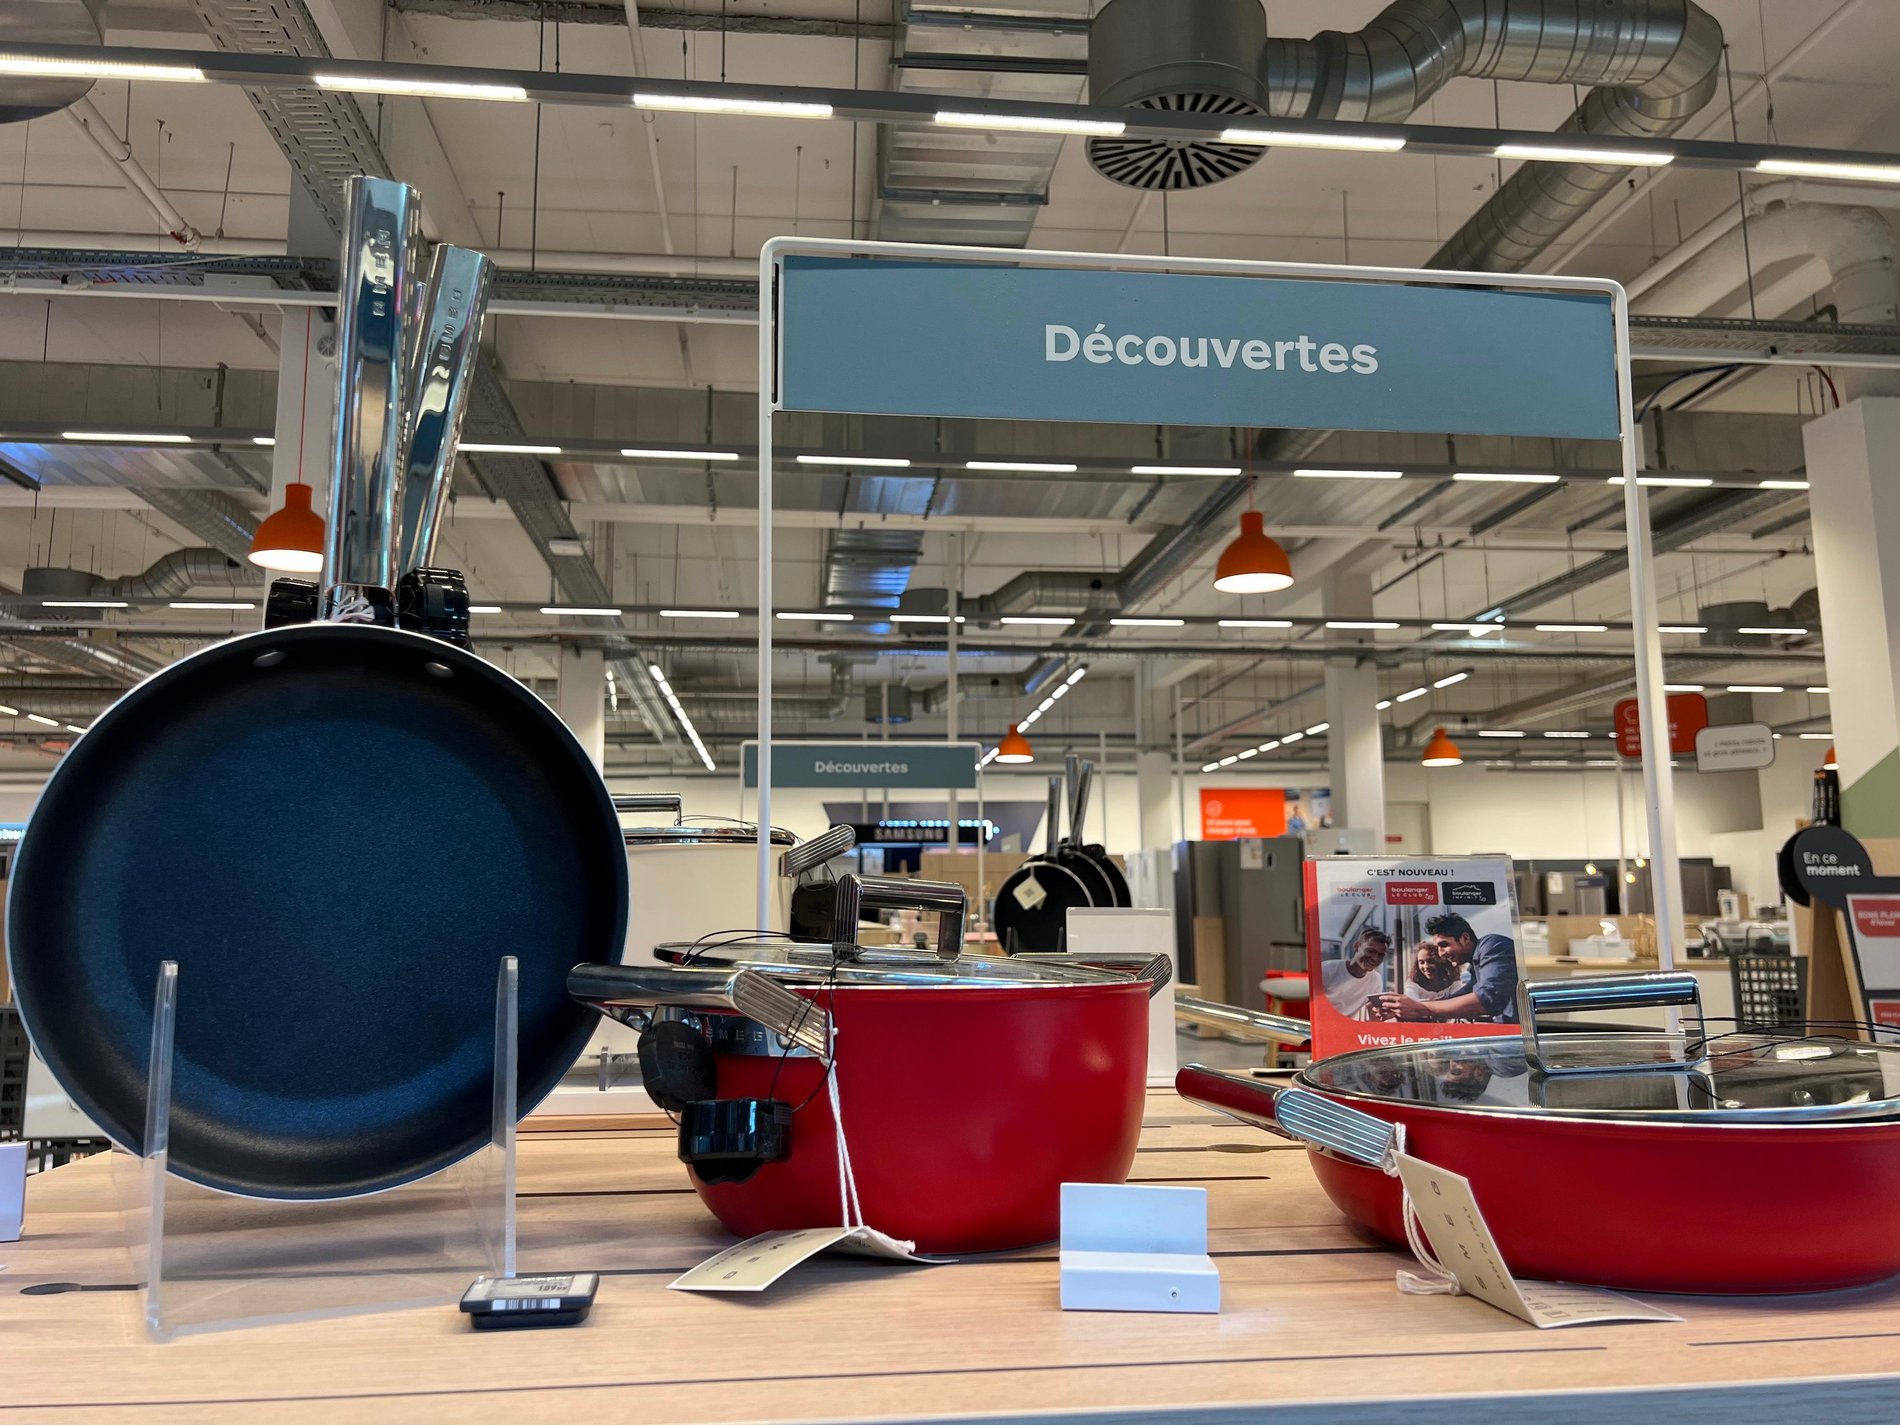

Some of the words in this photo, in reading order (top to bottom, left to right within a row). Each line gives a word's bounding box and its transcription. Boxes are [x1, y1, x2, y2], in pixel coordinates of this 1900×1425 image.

[1045, 323, 1379, 374] Découvertes
[815, 761, 909, 773] Découvertes
[874, 828, 944, 840] SAMSUNG
[1803, 852, 1820, 864] En
[1822, 854, 1838, 864] ce
[1367, 868, 1395, 877] C'EST
[1398, 868, 1448, 877] NOUVEAU
[1806, 864, 1861, 876] moment
[705, 1029, 763, 1041] SMEG
[1357, 1034, 1397, 1045] Vivez
[1401, 1034, 1414, 1044] le
[1430, 1181, 1488, 1291] SMEG
